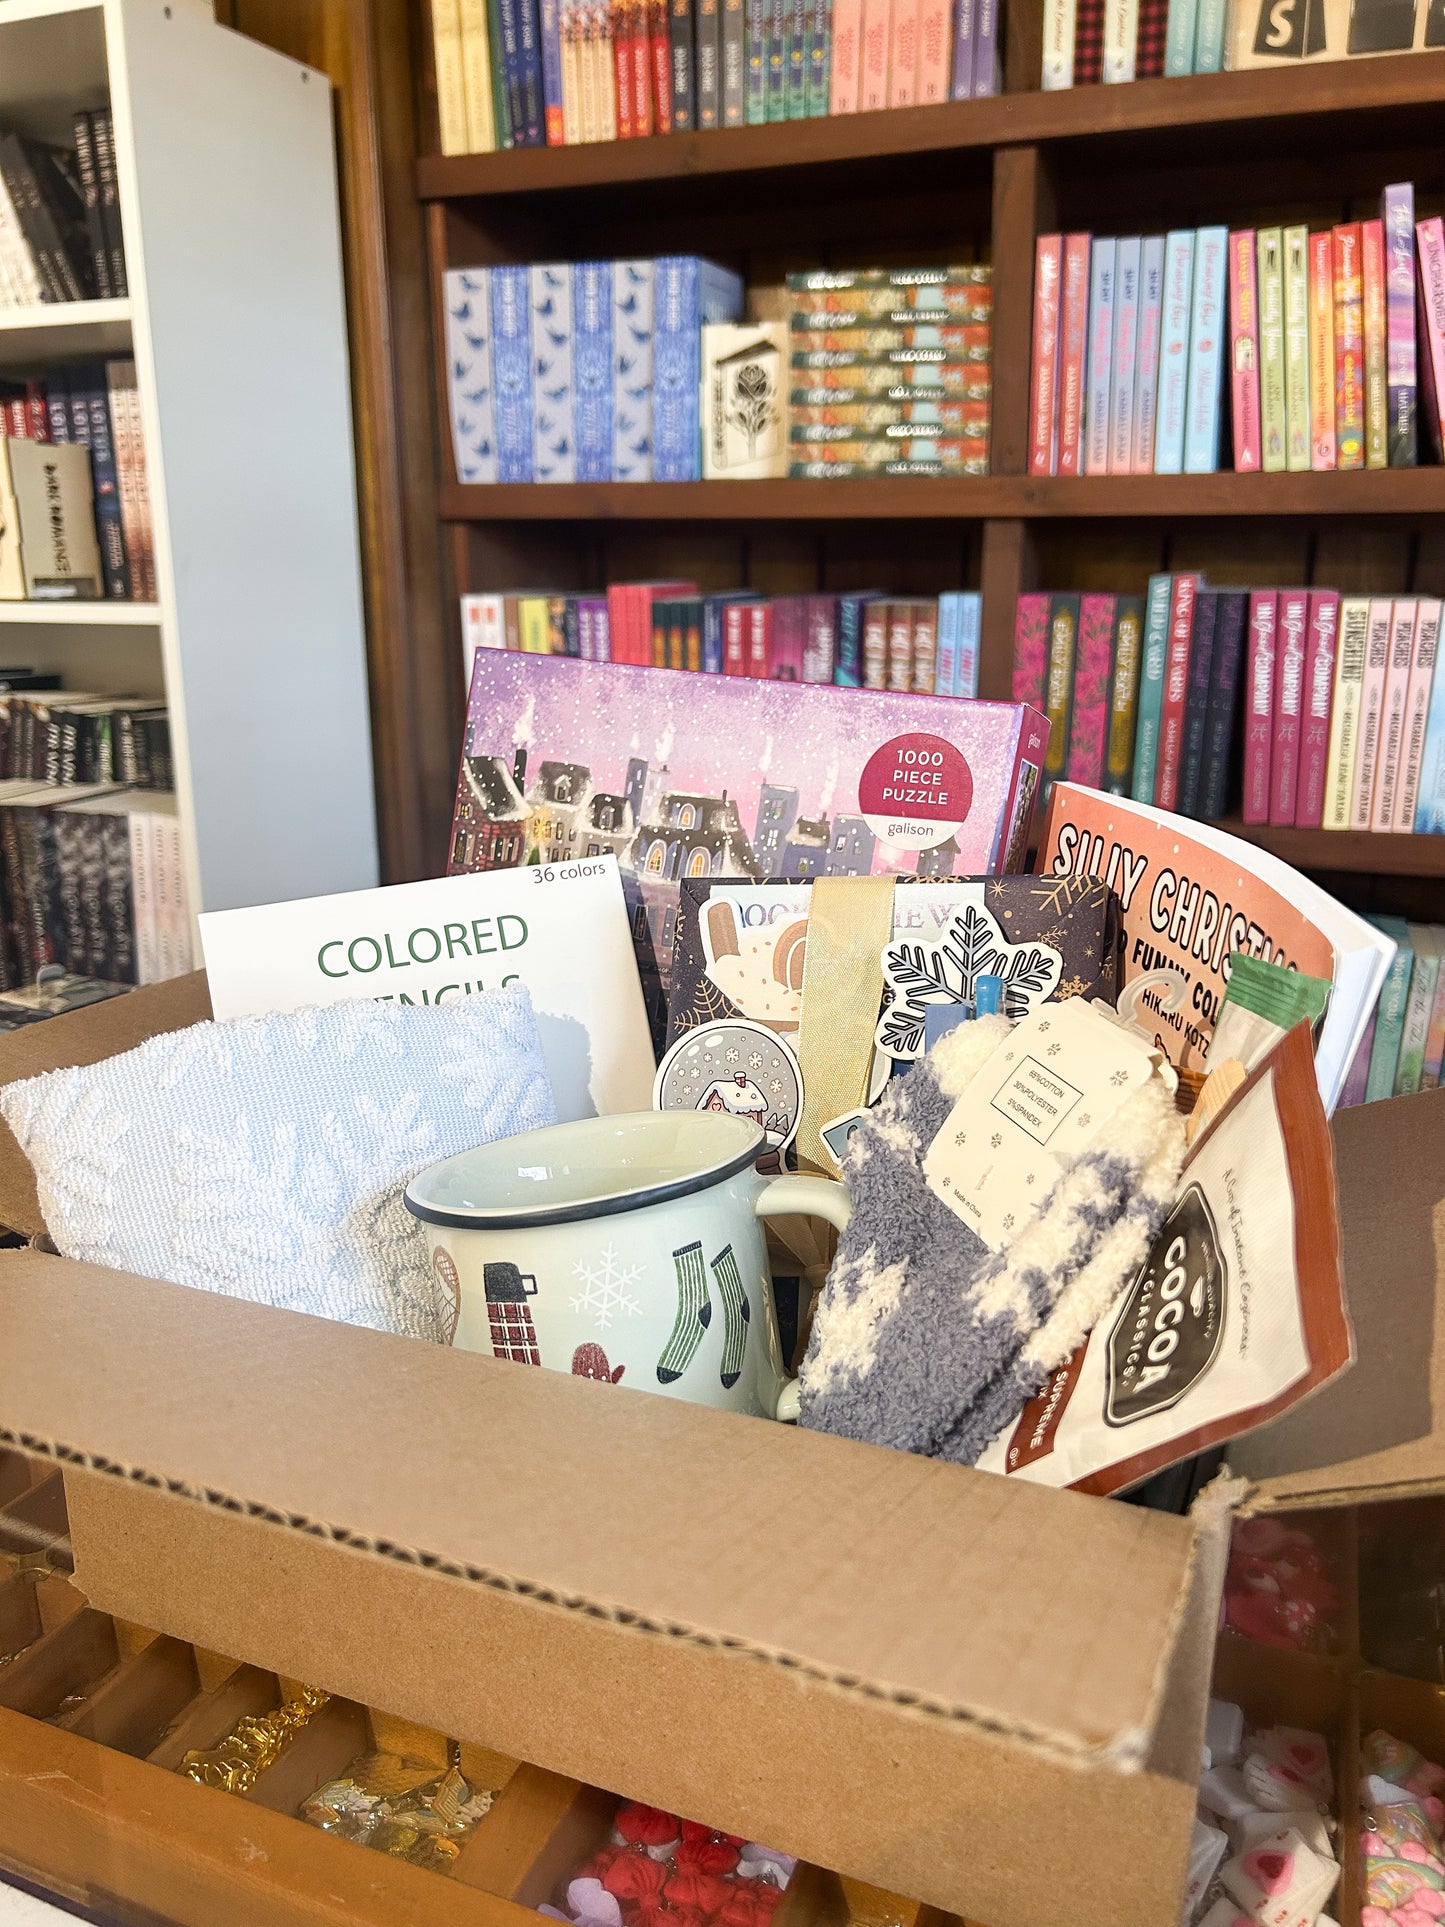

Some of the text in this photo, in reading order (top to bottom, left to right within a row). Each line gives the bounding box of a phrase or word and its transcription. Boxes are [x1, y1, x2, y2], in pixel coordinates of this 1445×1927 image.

[1265, 0, 1296, 48] S
[1150, 581, 1170, 630] WILD
[1256, 602, 1273, 620] IN
[1286, 601, 1303, 620] IN
[1319, 602, 1336, 622] IN
[1146, 631, 1164, 681] CARD
[1341, 609, 1366, 684] SUNSHINE
[1369, 620, 1387, 669] PEACHES
[1394, 620, 1411, 669] PEACHES
[1417, 620, 1436, 669] PEACHES
[1168, 642, 1186, 703] HEARTS
[1253, 655, 1271, 716] COMPANY
[1281, 654, 1299, 716] COMPANY
[1311, 656, 1332, 720] COMPANY
[892, 768, 943, 787] PIECE
[896, 748, 943, 767] 1000
[881, 786, 949, 806] PUZZLE
[886, 819, 934, 838] galison
[532, 861, 606, 884] 36 colors
[316, 913, 529, 979] COLORED
[1149, 867, 1299, 984] CHRIST
[1006, 1096, 1042, 1130] 5%SPANDEX
[1012, 1079, 1059, 1118] 30%POLYESTER
[953, 1188, 966, 1203] Made
[969, 1203, 982, 1218] China
[1121, 1279, 1154, 1380] CLASSICS
[1132, 1235, 1187, 1394] COCOA
[1029, 1370, 1069, 1449] SUPREME
